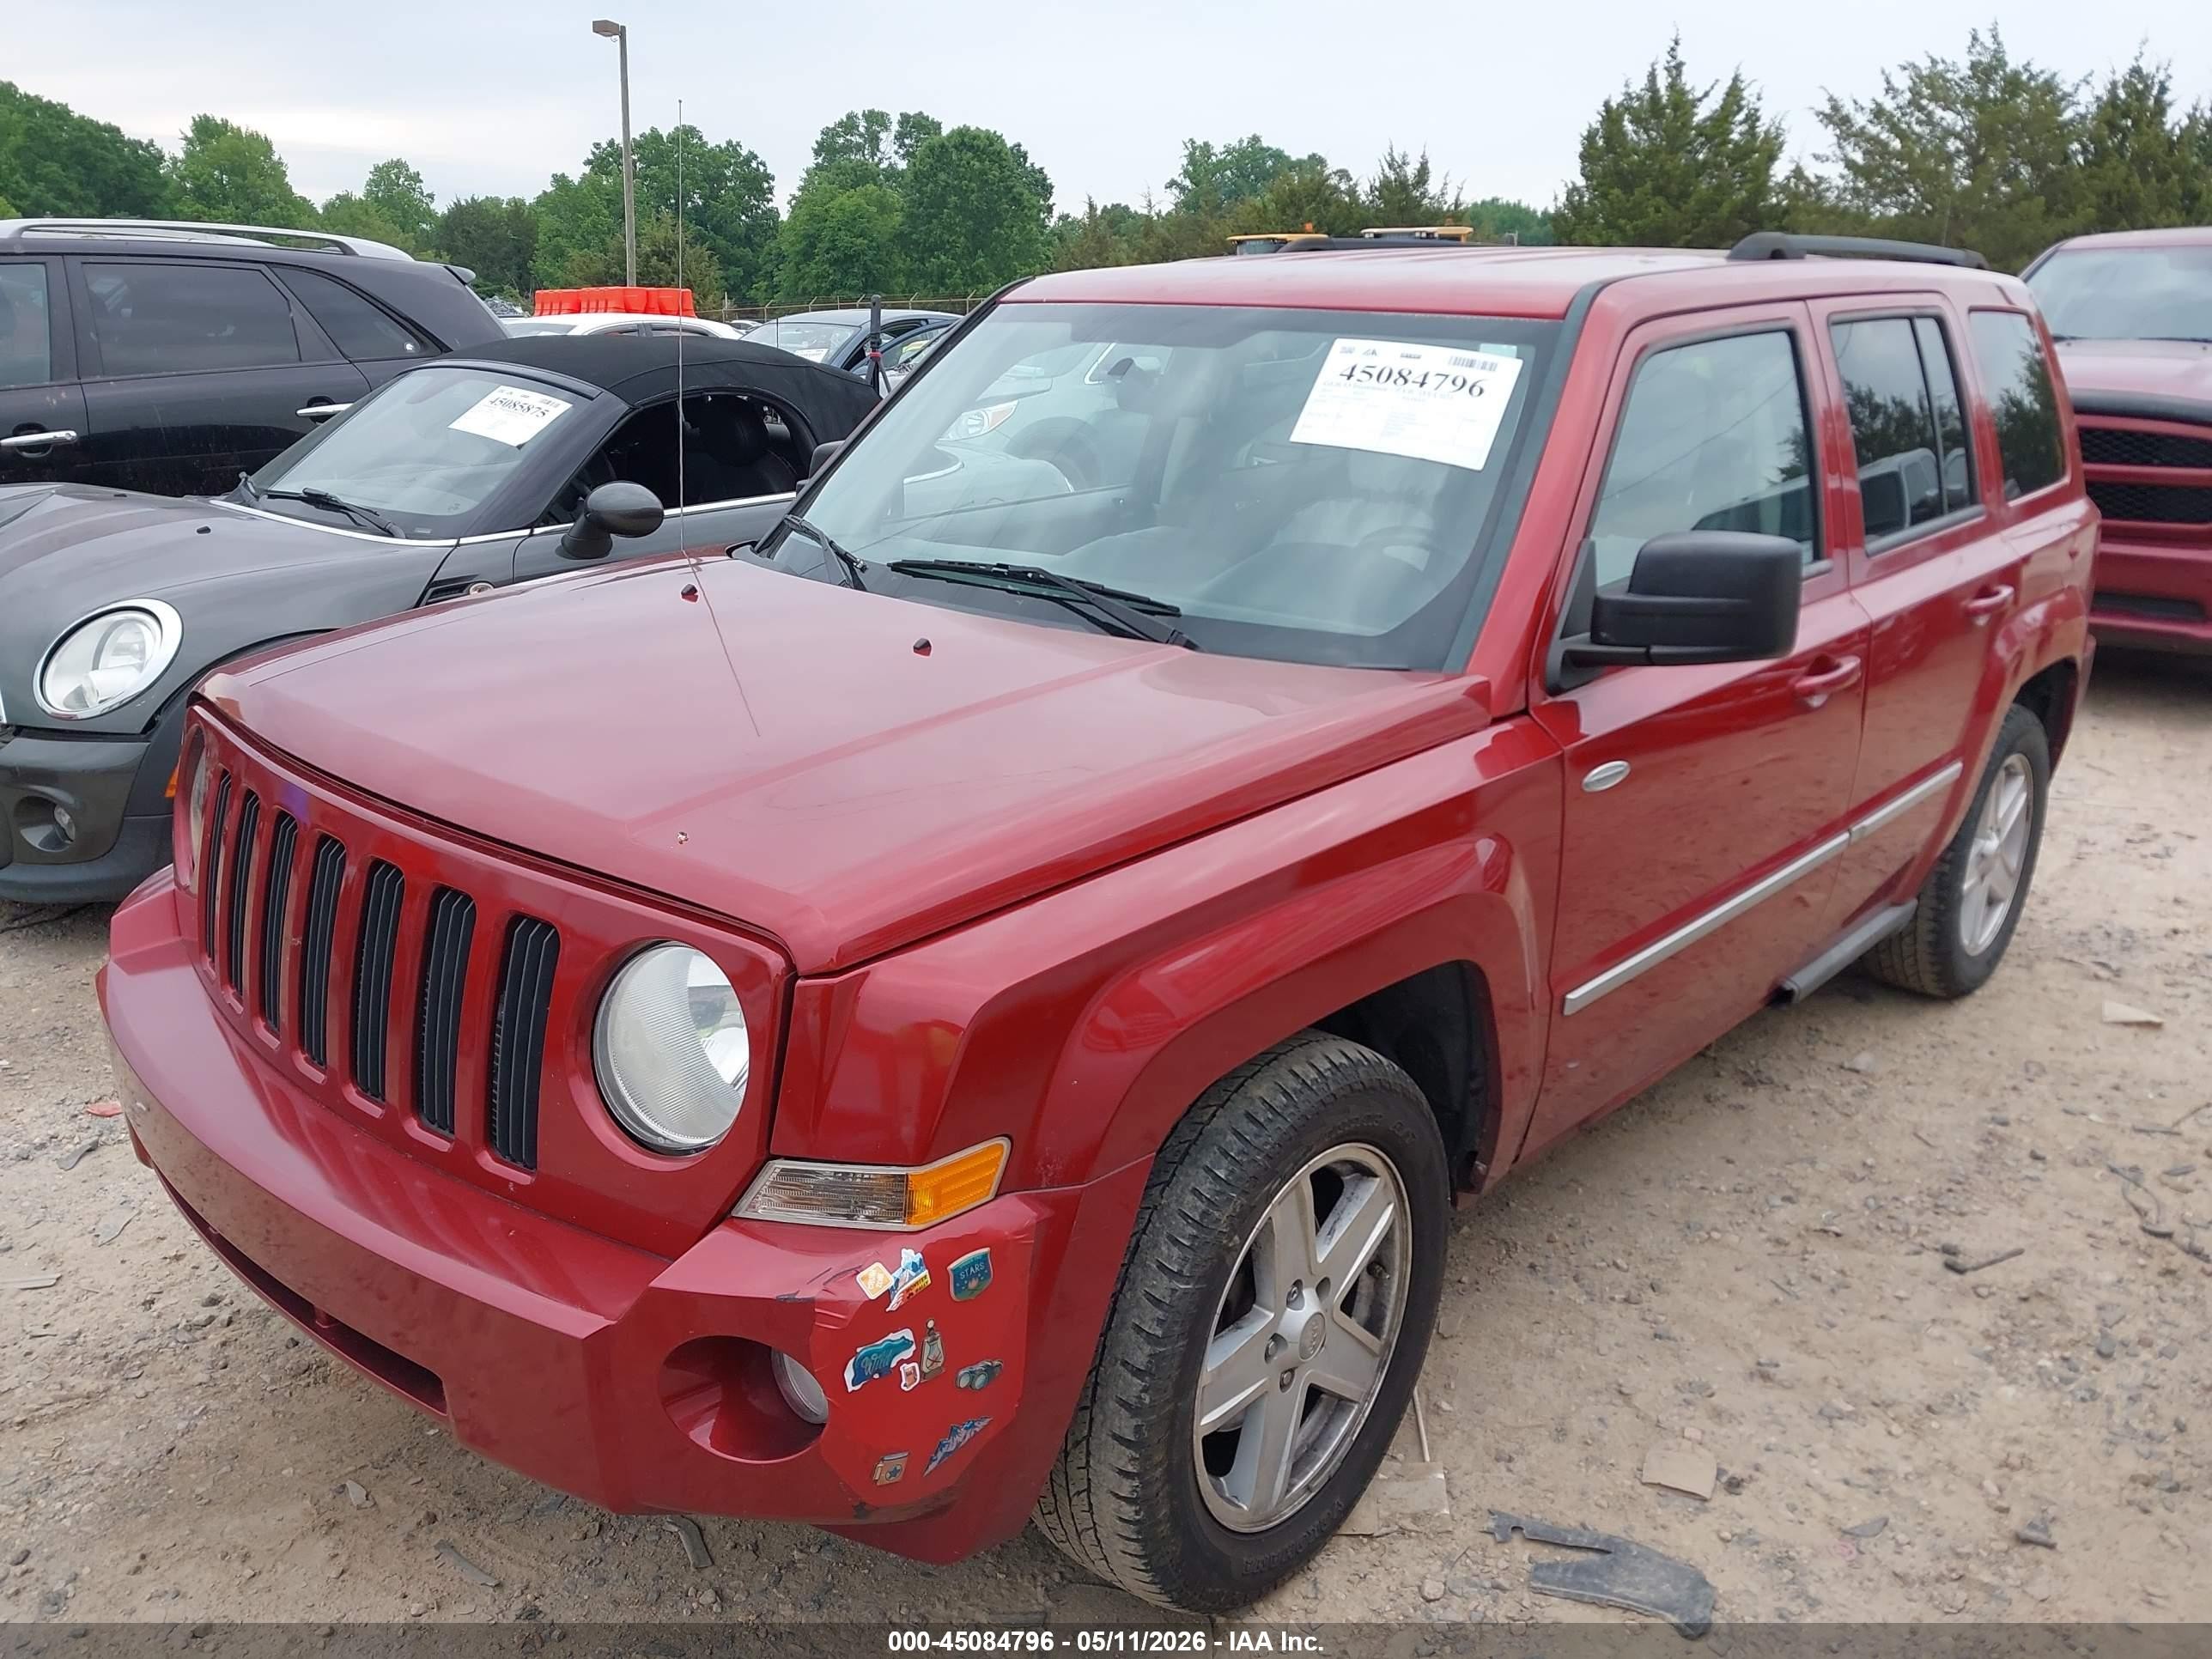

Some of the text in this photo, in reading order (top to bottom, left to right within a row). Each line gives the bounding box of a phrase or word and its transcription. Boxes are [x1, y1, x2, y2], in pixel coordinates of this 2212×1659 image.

[1339, 362, 1487, 398] 45084796
[489, 396, 550, 418] 45085875
[959, 1261, 986, 1279] STARS
